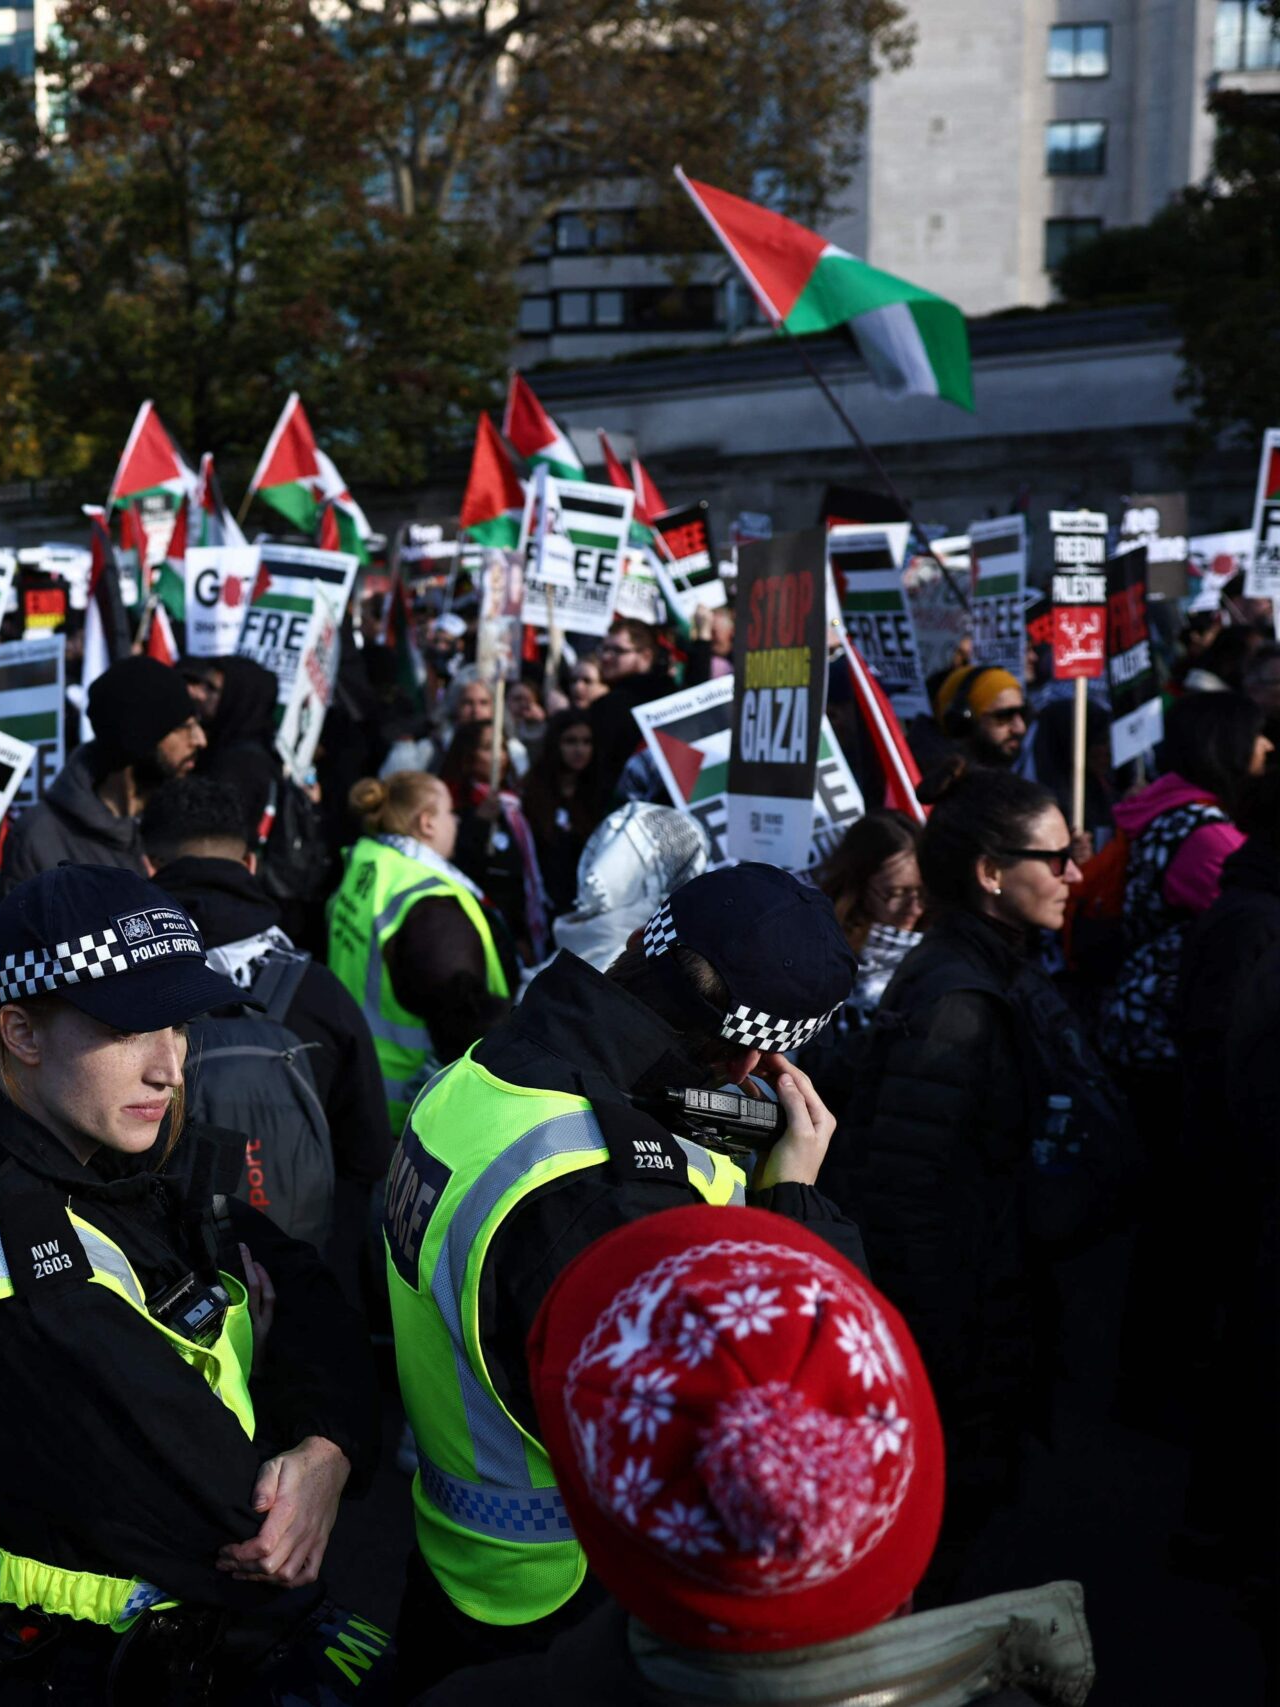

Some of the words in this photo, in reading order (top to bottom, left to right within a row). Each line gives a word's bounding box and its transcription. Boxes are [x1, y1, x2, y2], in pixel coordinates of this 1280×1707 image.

[1052, 574, 1107, 604] PALESTINE
[748, 570, 814, 649] STOP
[972, 597, 1021, 639] FREE
[238, 610, 310, 652] FRE
[843, 614, 914, 658] FREE
[744, 646, 811, 688] BOMBING
[645, 700, 693, 722] Palestine
[740, 686, 809, 764] GAZA
[130, 940, 173, 963] POLICE
[171, 938, 202, 953] OFFICER
[632, 1140, 662, 1153] NW
[633, 1154, 675, 1170] 2294
[245, 1138, 272, 1207] port
[30, 1238, 60, 1262] NW
[32, 1253, 73, 1280] 2603
